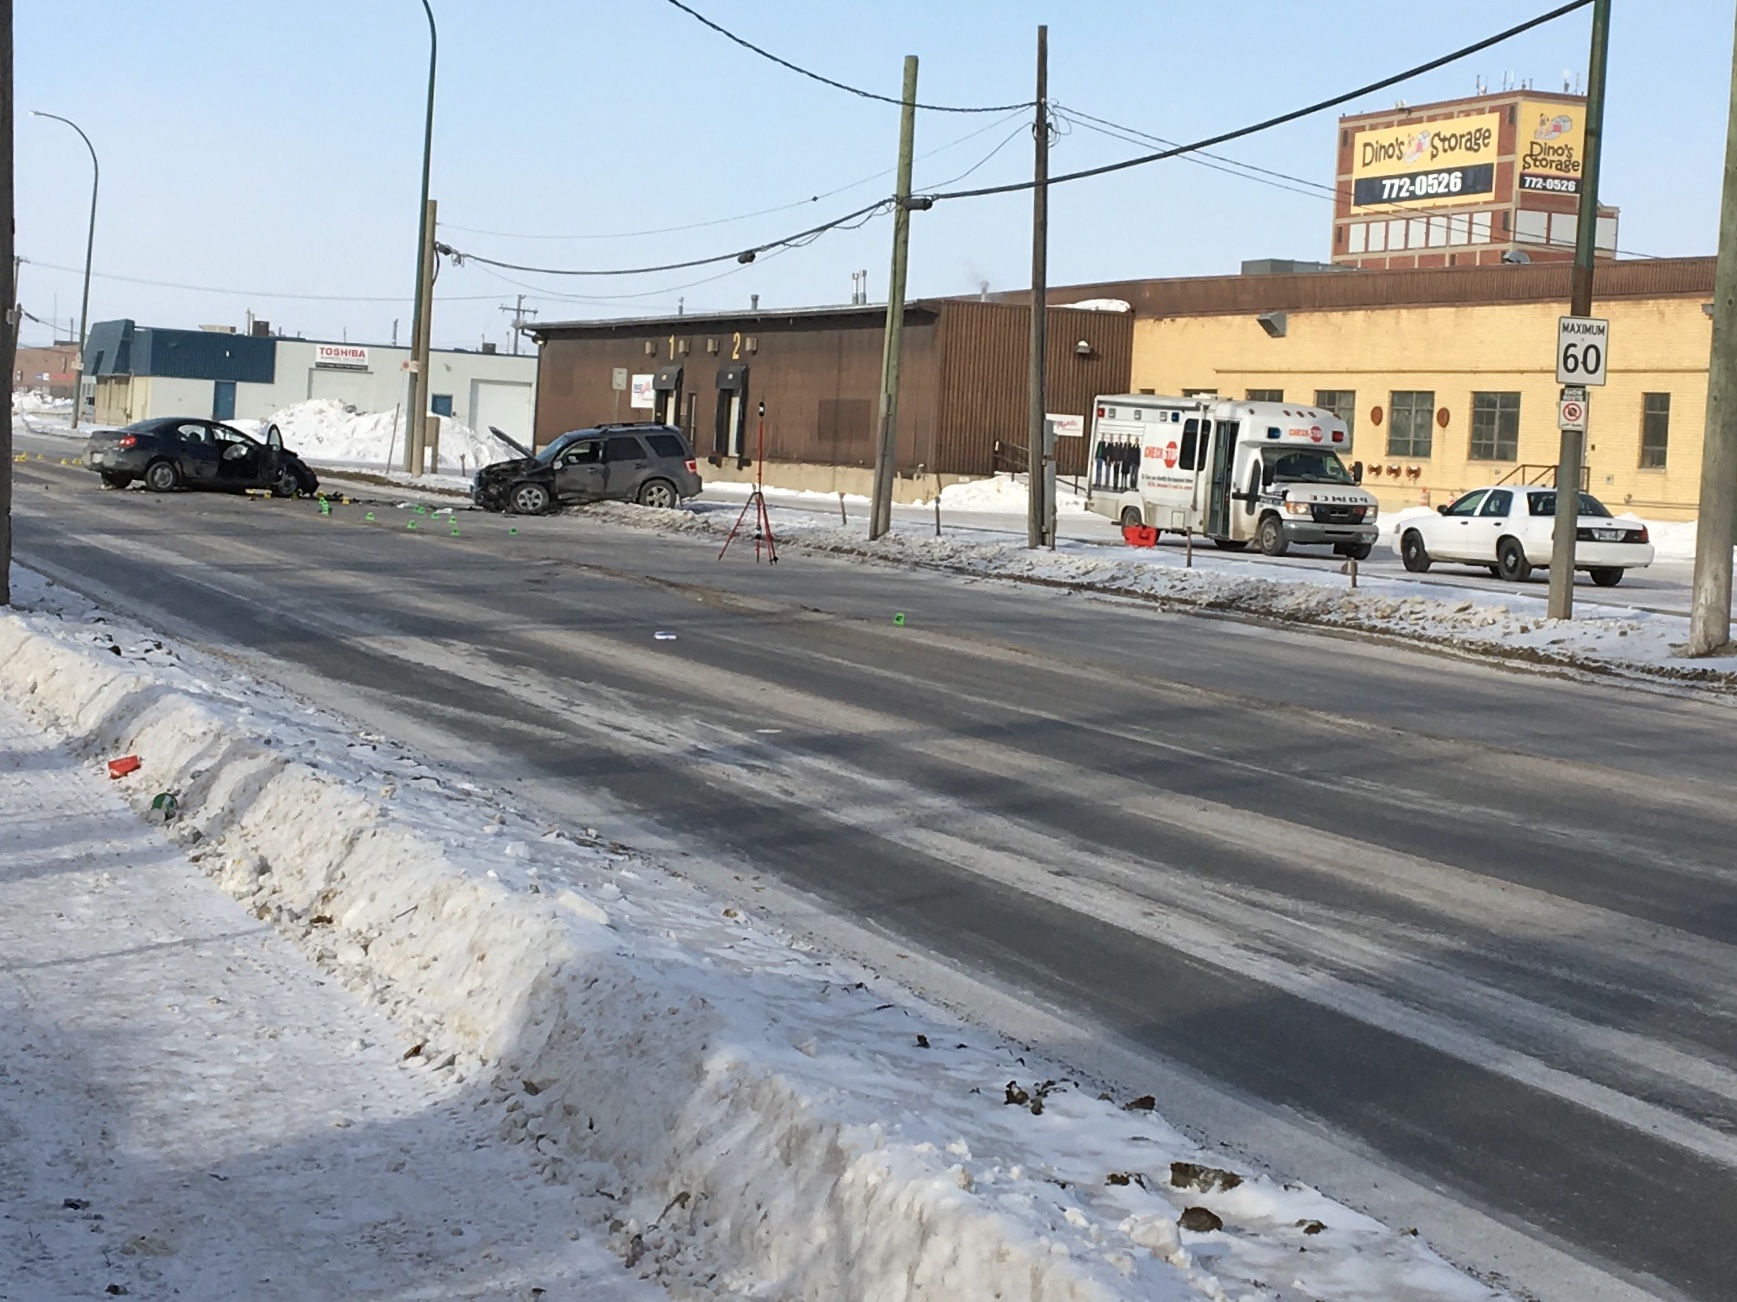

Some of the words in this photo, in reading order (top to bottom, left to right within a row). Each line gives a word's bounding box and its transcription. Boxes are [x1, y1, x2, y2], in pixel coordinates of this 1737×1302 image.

[1362, 137, 1405, 168] Dino's
[1430, 127, 1492, 161] Storage
[1529, 141, 1574, 158] Dino's
[1522, 154, 1580, 173] Storage
[1382, 171, 1463, 199] 772-0526
[1524, 176, 1577, 192] 772-0526
[1562, 322, 1606, 336] MAXIMUM
[319, 347, 366, 358] TOSHIBA
[668, 334, 676, 361] 1
[731, 332, 741, 360] 2
[1562, 343, 1601, 375] 60
